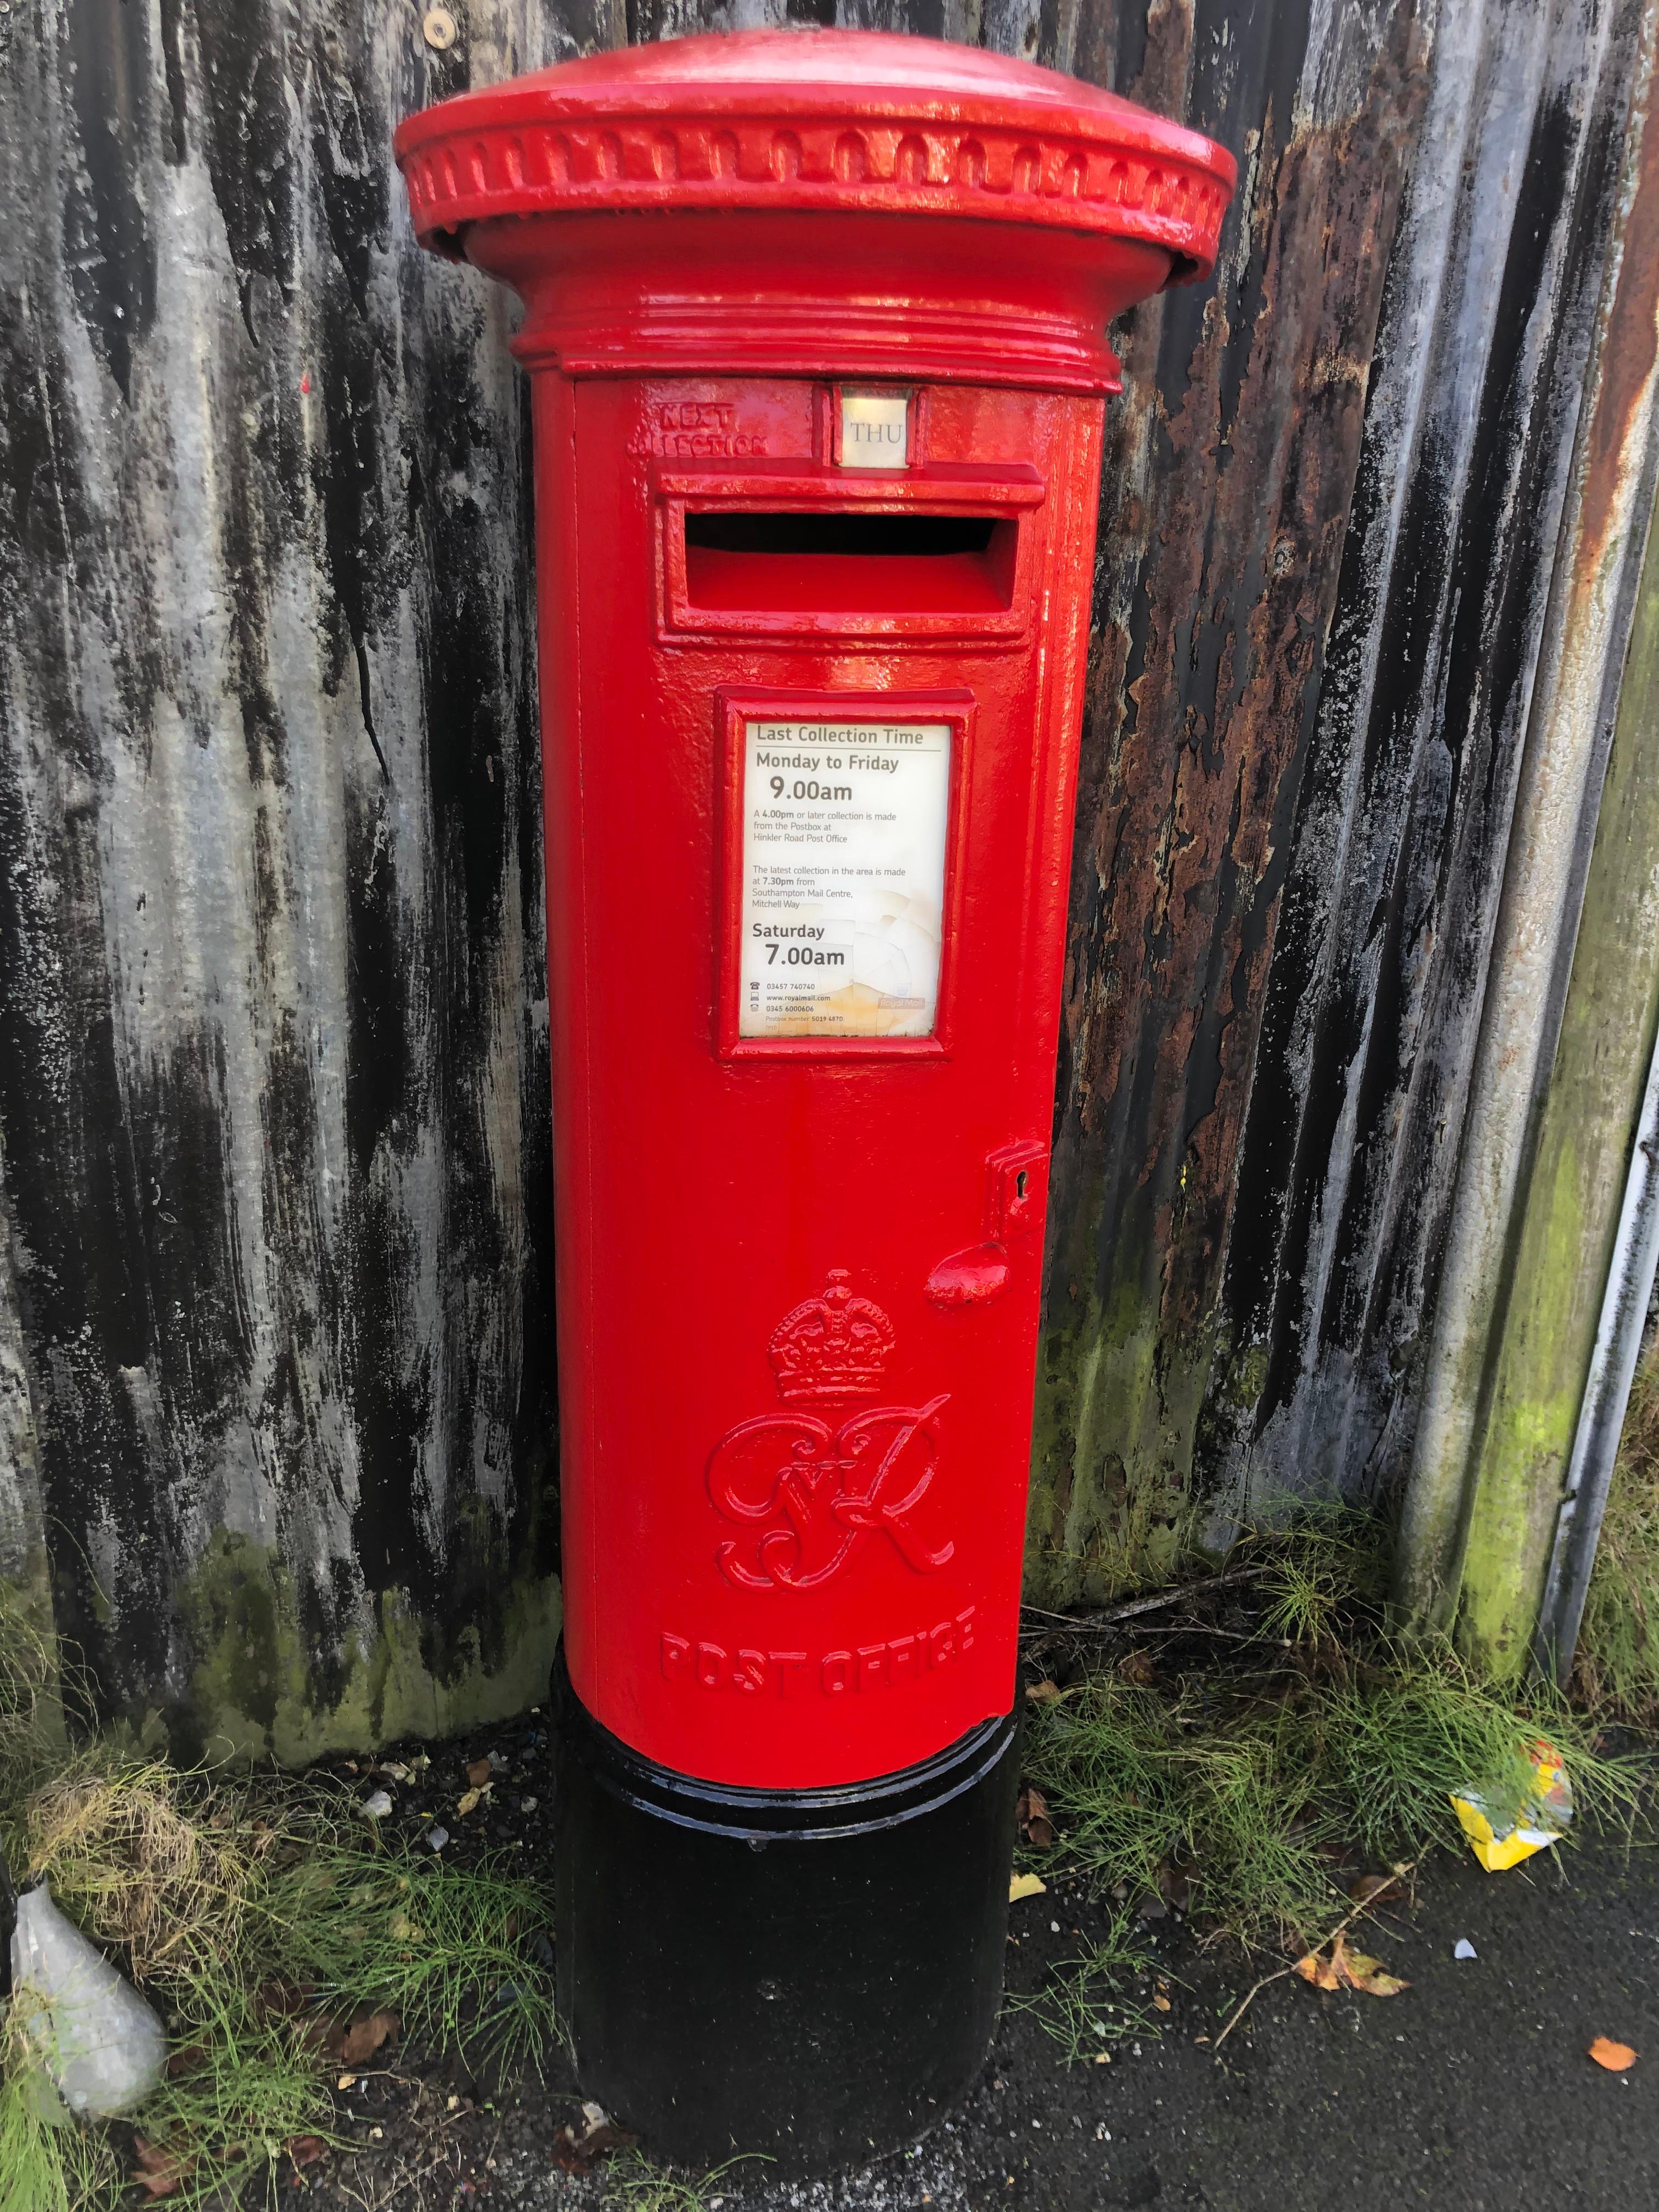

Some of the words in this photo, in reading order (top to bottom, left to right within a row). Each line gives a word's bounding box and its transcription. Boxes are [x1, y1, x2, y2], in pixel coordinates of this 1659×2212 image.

[660, 402, 735, 431] NEXT
[850, 422, 903, 444] THU
[757, 725, 792, 741] Last
[798, 726, 877, 743] Collection
[883, 729, 923, 744] Time
[757, 752, 820, 771] Monday
[827, 755, 842, 769] to
[849, 755, 899, 774] Friday
[770, 776, 852, 800] 9.00am
[762, 810, 794, 820] 4.00pm
[827, 812, 864, 820] collection
[874, 812, 896, 821] made
[791, 822, 821, 831] Postbox
[754, 833, 782, 842] Hinkler
[785, 834, 804, 842] Road
[753, 866, 768, 874] The
[770, 866, 791, 874] latest
[794, 866, 830, 875] collection
[763, 877, 794, 887] 7.30pm
[752, 888, 805, 899] Southampton
[808, 889, 823, 898] Mail
[826, 890, 853, 899] Centre,
[752, 900, 781, 908] Mitchell
[783, 900, 800, 910] Way
[753, 923, 825, 940] Saturday
[765, 944, 844, 965] 7.00am
[881, 999, 902, 1007] Royal
[660, 1631, 808, 1699] POST
[820, 1605, 977, 1695] OFFICE
